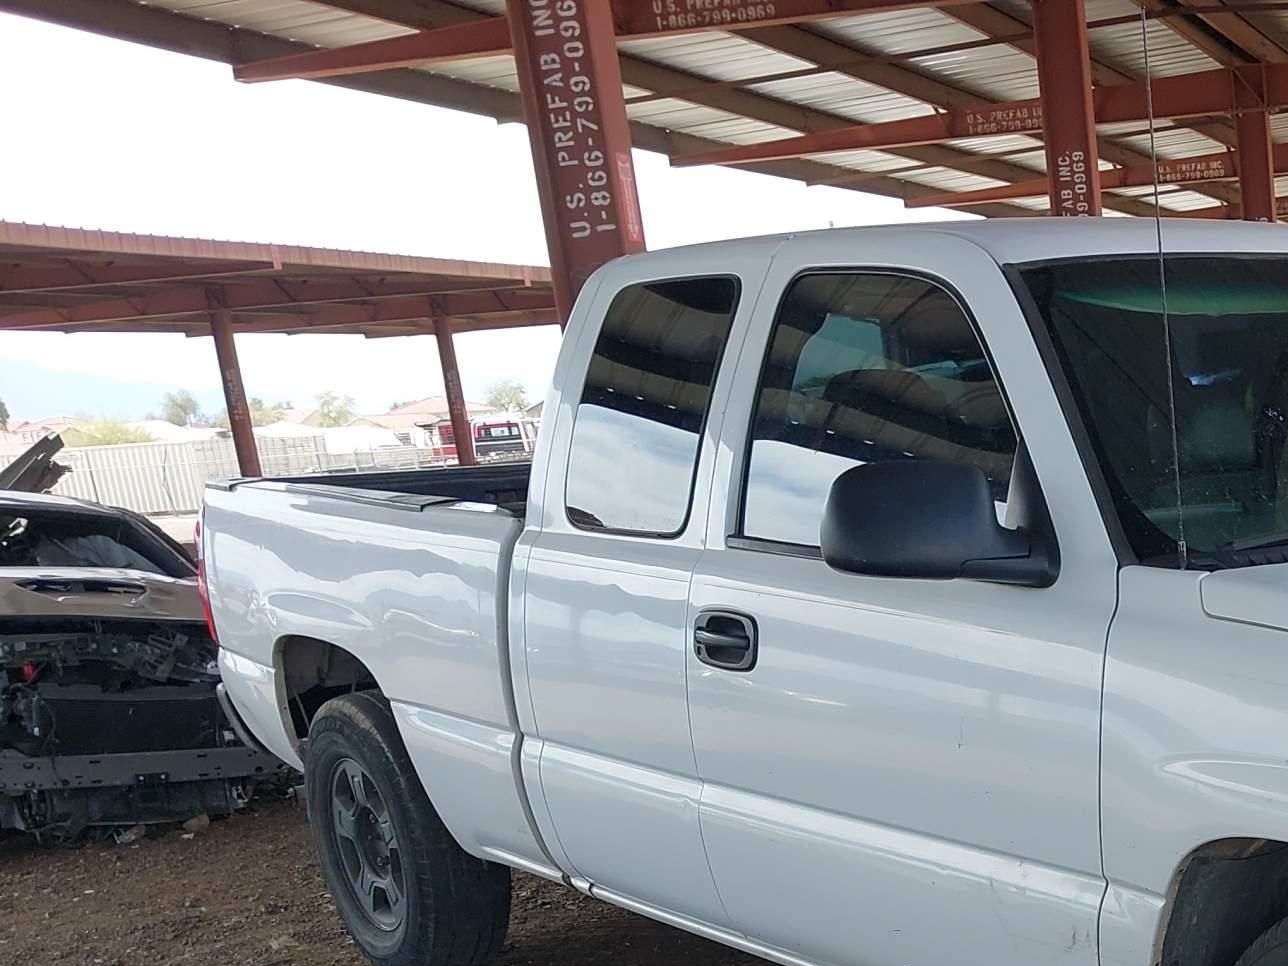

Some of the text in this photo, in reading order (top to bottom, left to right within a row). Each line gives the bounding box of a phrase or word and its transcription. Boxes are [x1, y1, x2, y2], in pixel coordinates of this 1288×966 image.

[541, 53, 579, 166] PREFAB
[990, 107, 1028, 121] PREFAB
[1058, 151, 1072, 181] INC.
[566, 183, 591, 238] U.S.
